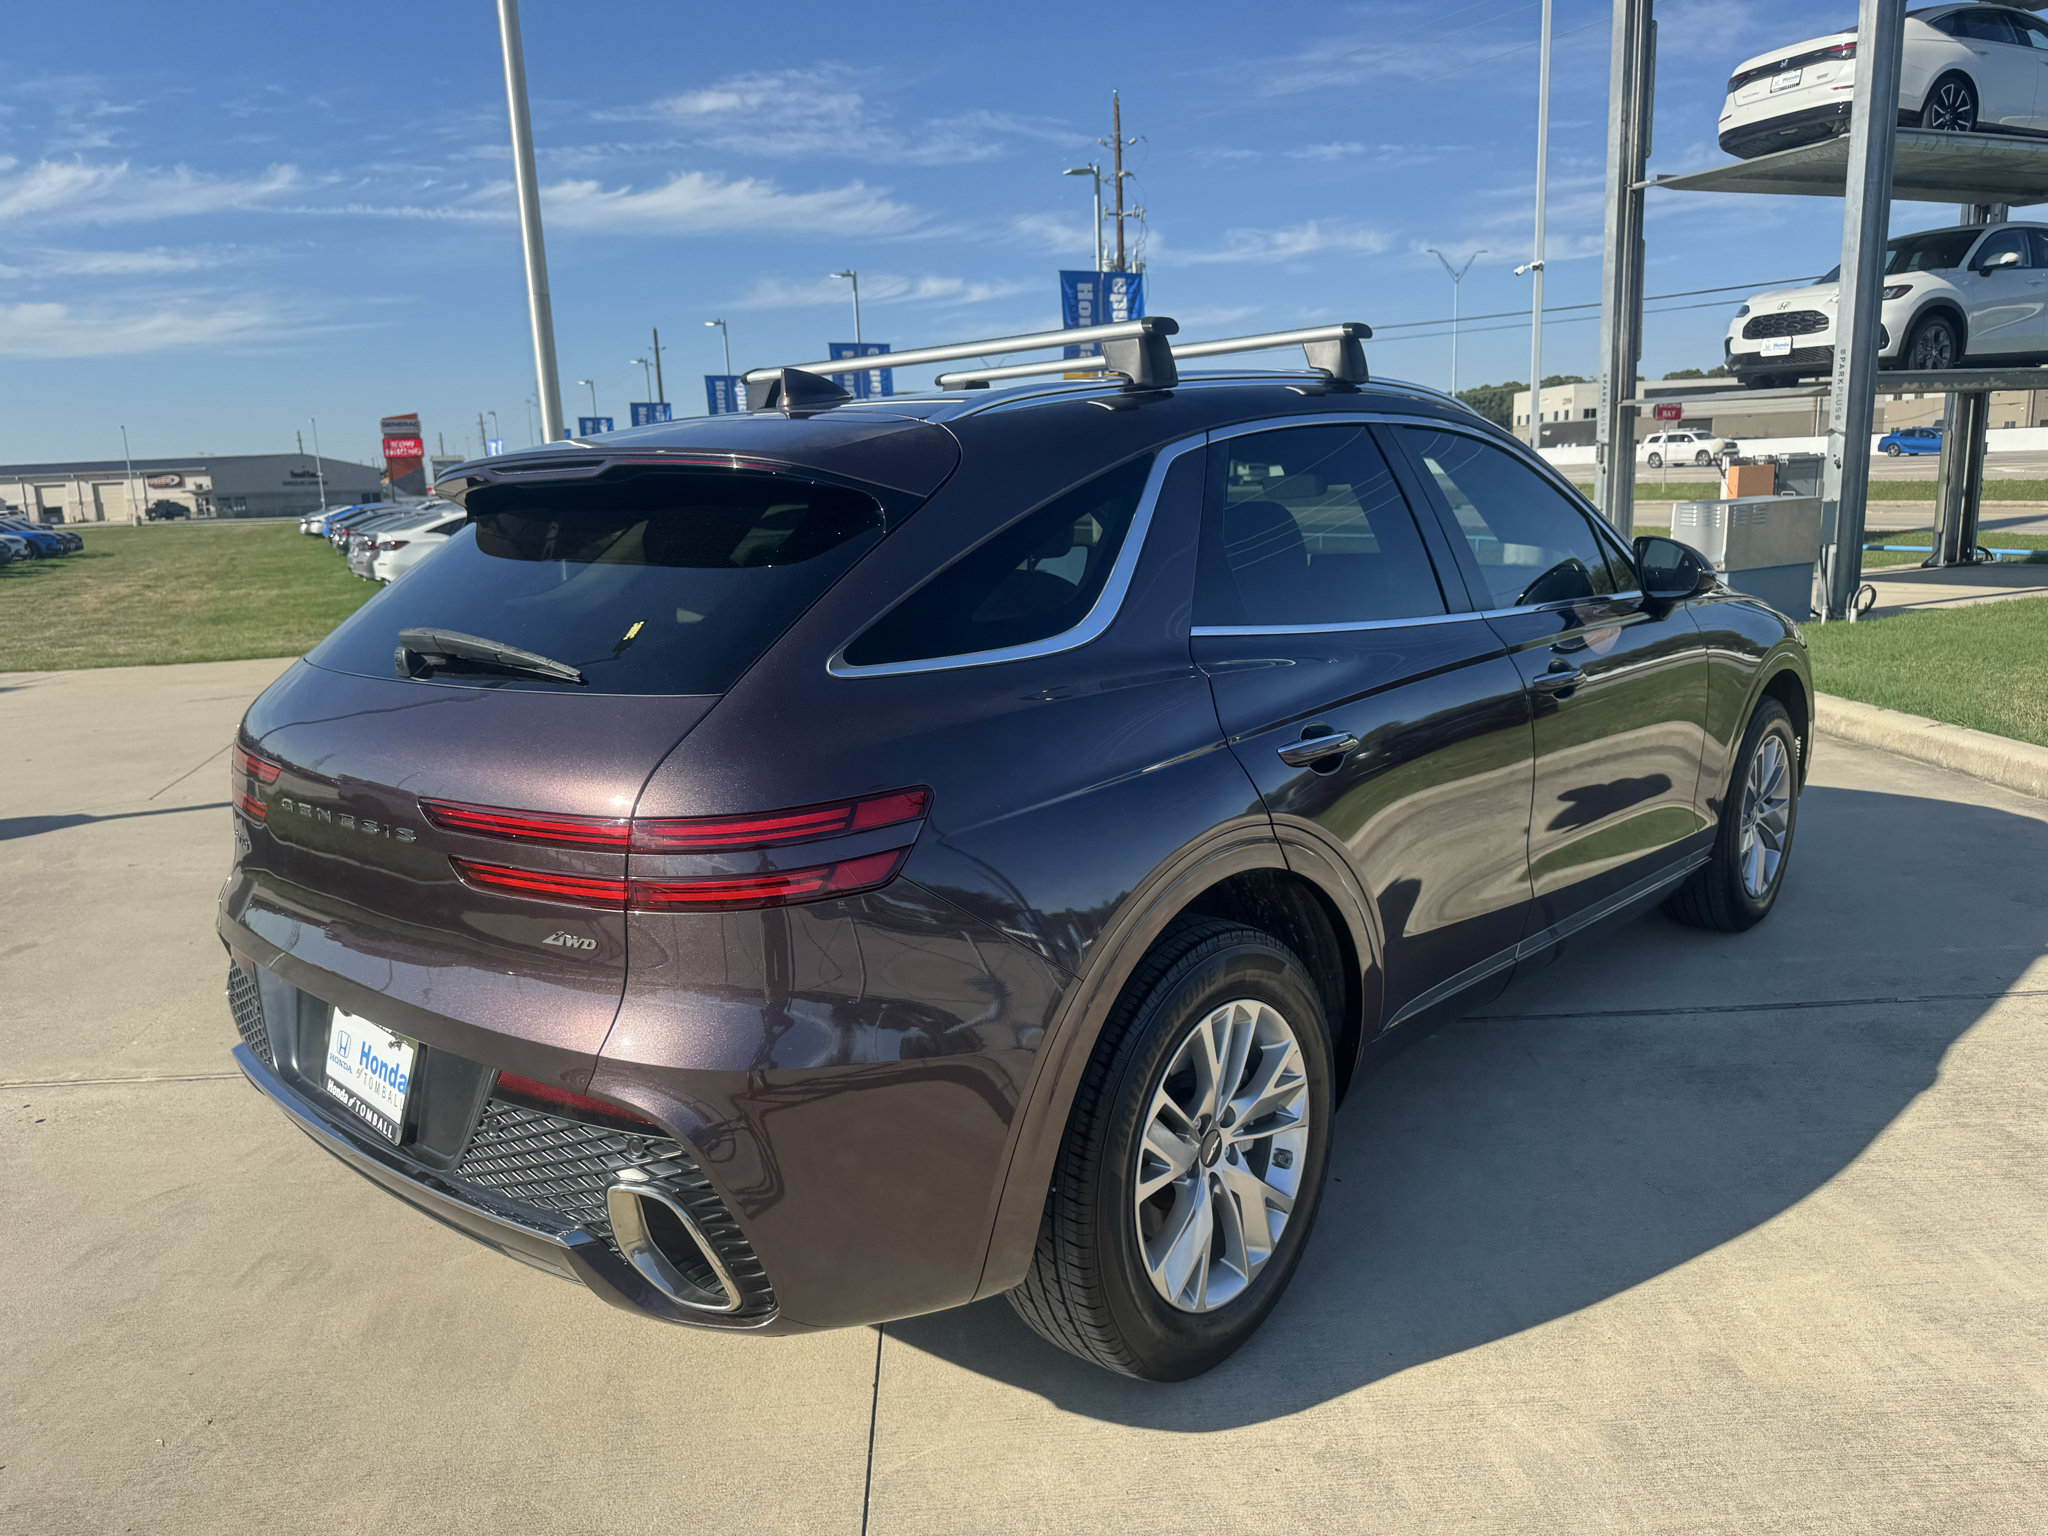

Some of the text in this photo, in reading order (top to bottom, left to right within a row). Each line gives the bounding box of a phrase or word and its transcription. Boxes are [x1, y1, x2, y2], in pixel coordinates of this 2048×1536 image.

[1662, 410, 1677, 418] WAY
[281, 797, 417, 843] GENESIS
[329, 1053, 352, 1074] HONDA
[356, 1067, 364, 1079] of
[360, 1041, 407, 1095] Honda
[327, 1079, 392, 1139] Honda of TOMBALL
